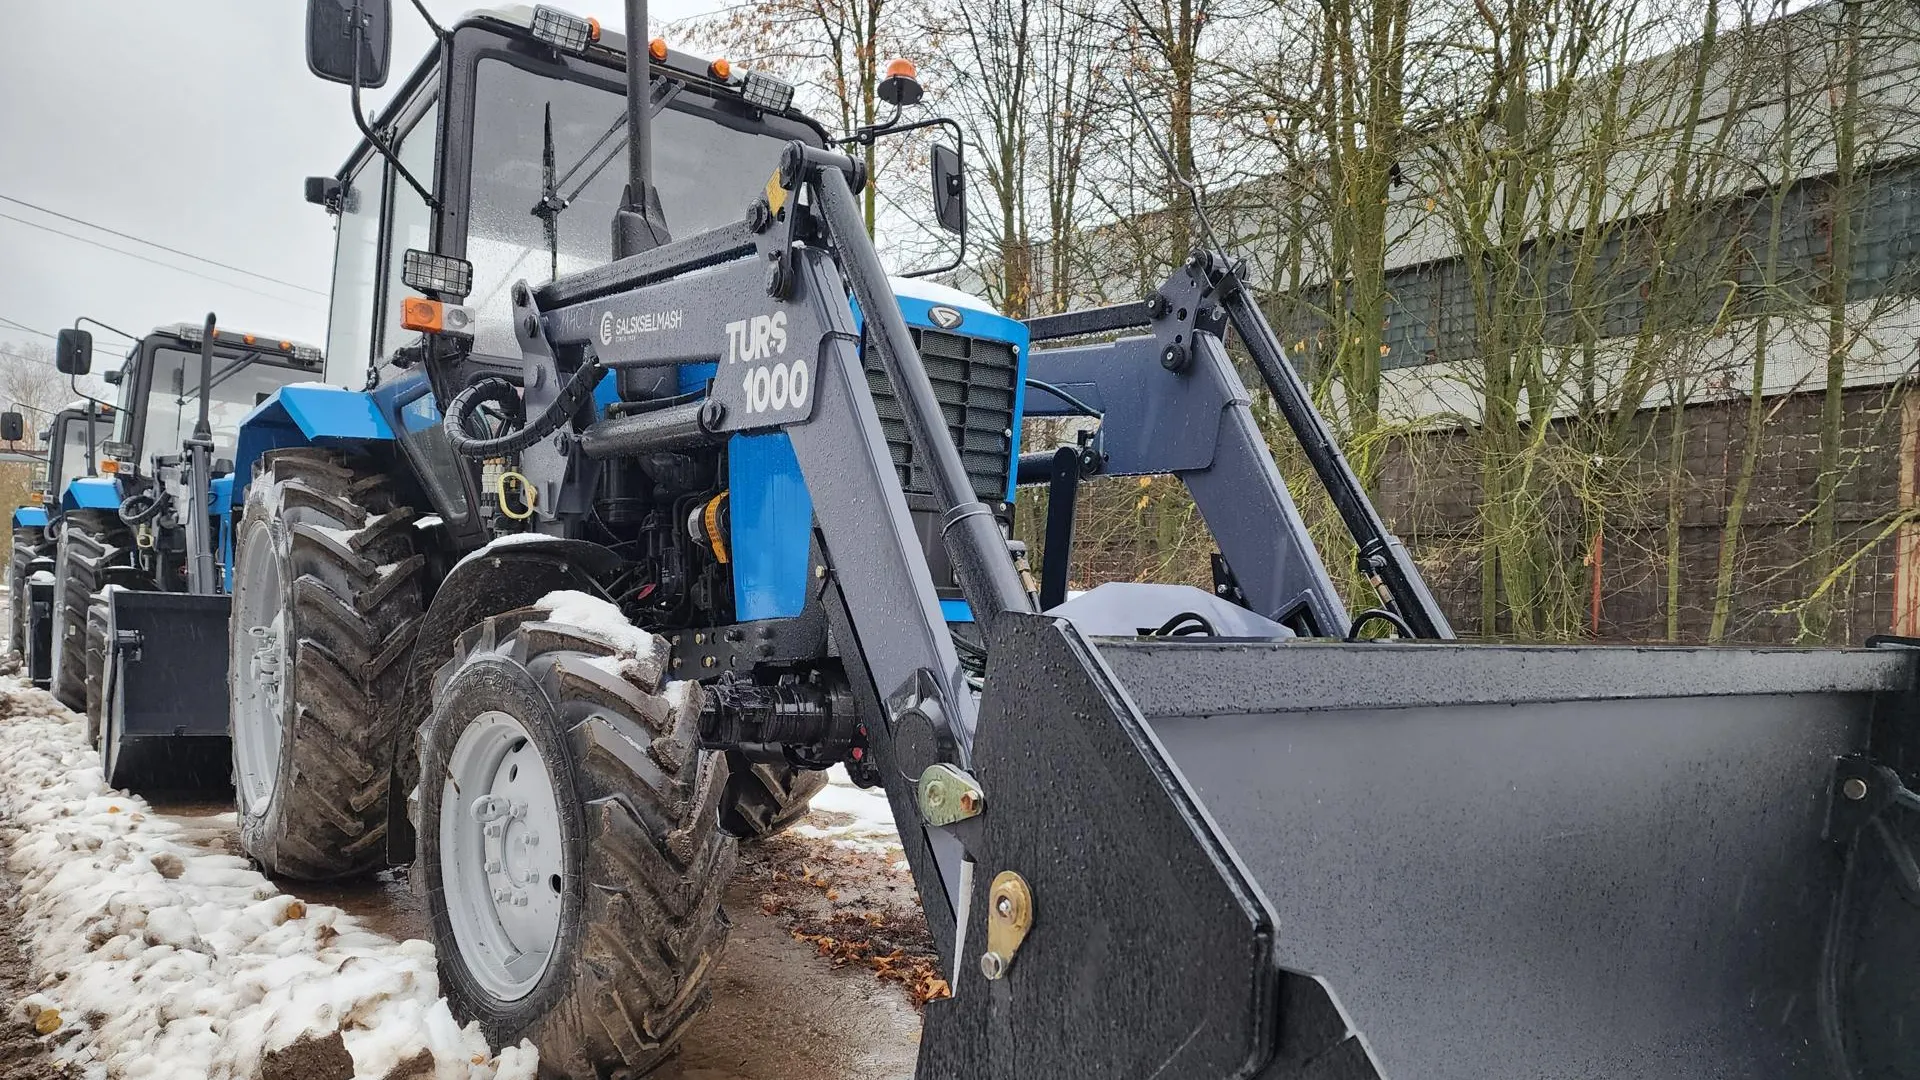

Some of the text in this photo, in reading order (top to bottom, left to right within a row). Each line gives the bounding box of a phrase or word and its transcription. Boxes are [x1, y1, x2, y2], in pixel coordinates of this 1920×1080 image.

[615, 310, 682, 335] SALSKSELMASH
[725, 310, 787, 364] TURS
[743, 359, 808, 413] 1000
